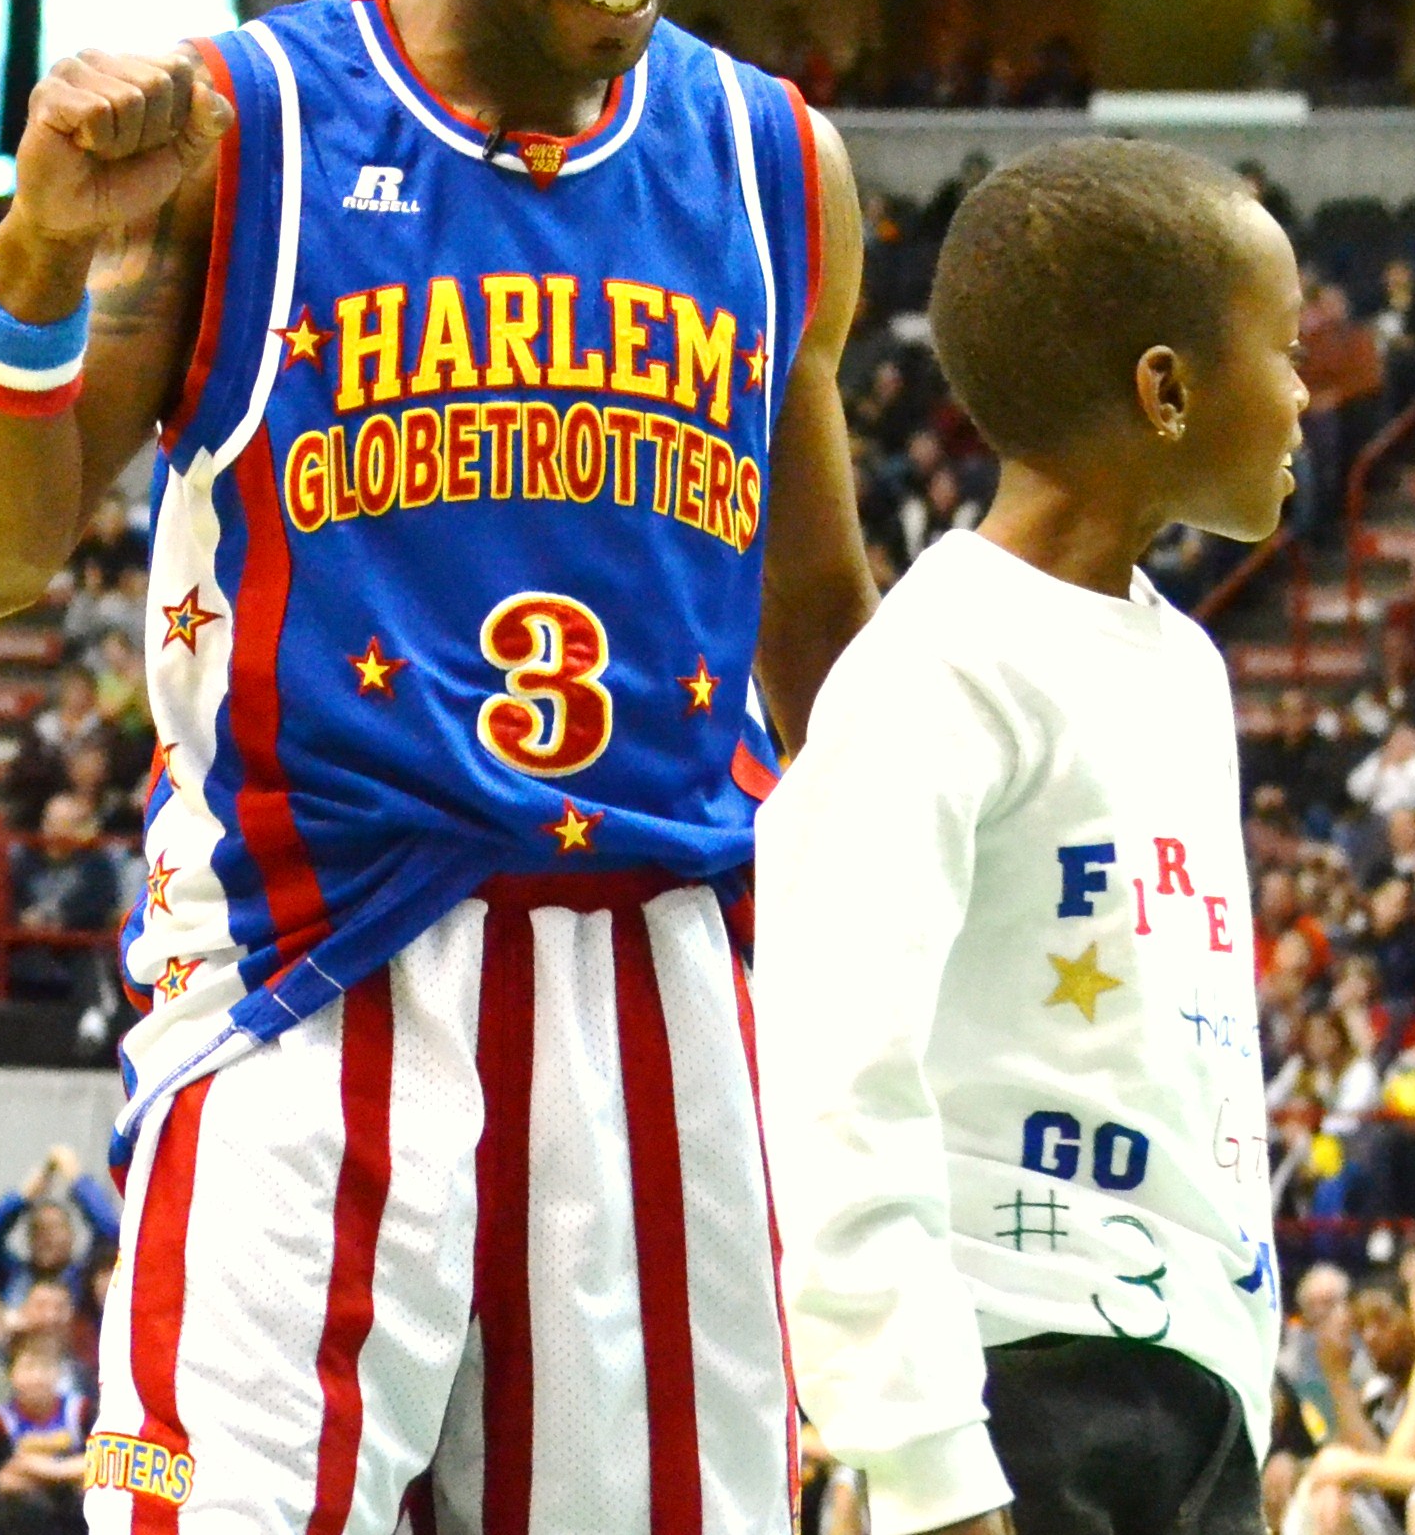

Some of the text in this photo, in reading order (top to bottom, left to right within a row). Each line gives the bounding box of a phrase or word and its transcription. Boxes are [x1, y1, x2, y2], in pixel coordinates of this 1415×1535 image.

[352, 165, 404, 200] R
[524, 143, 568, 158] SINCE
[342, 196, 421, 214] RUSSELL
[334, 271, 740, 431] HARLEM
[282, 399, 763, 555] GLOBETROTTERS
[477, 590, 613, 778] 3
[1021, 1110, 1150, 1191] GO
